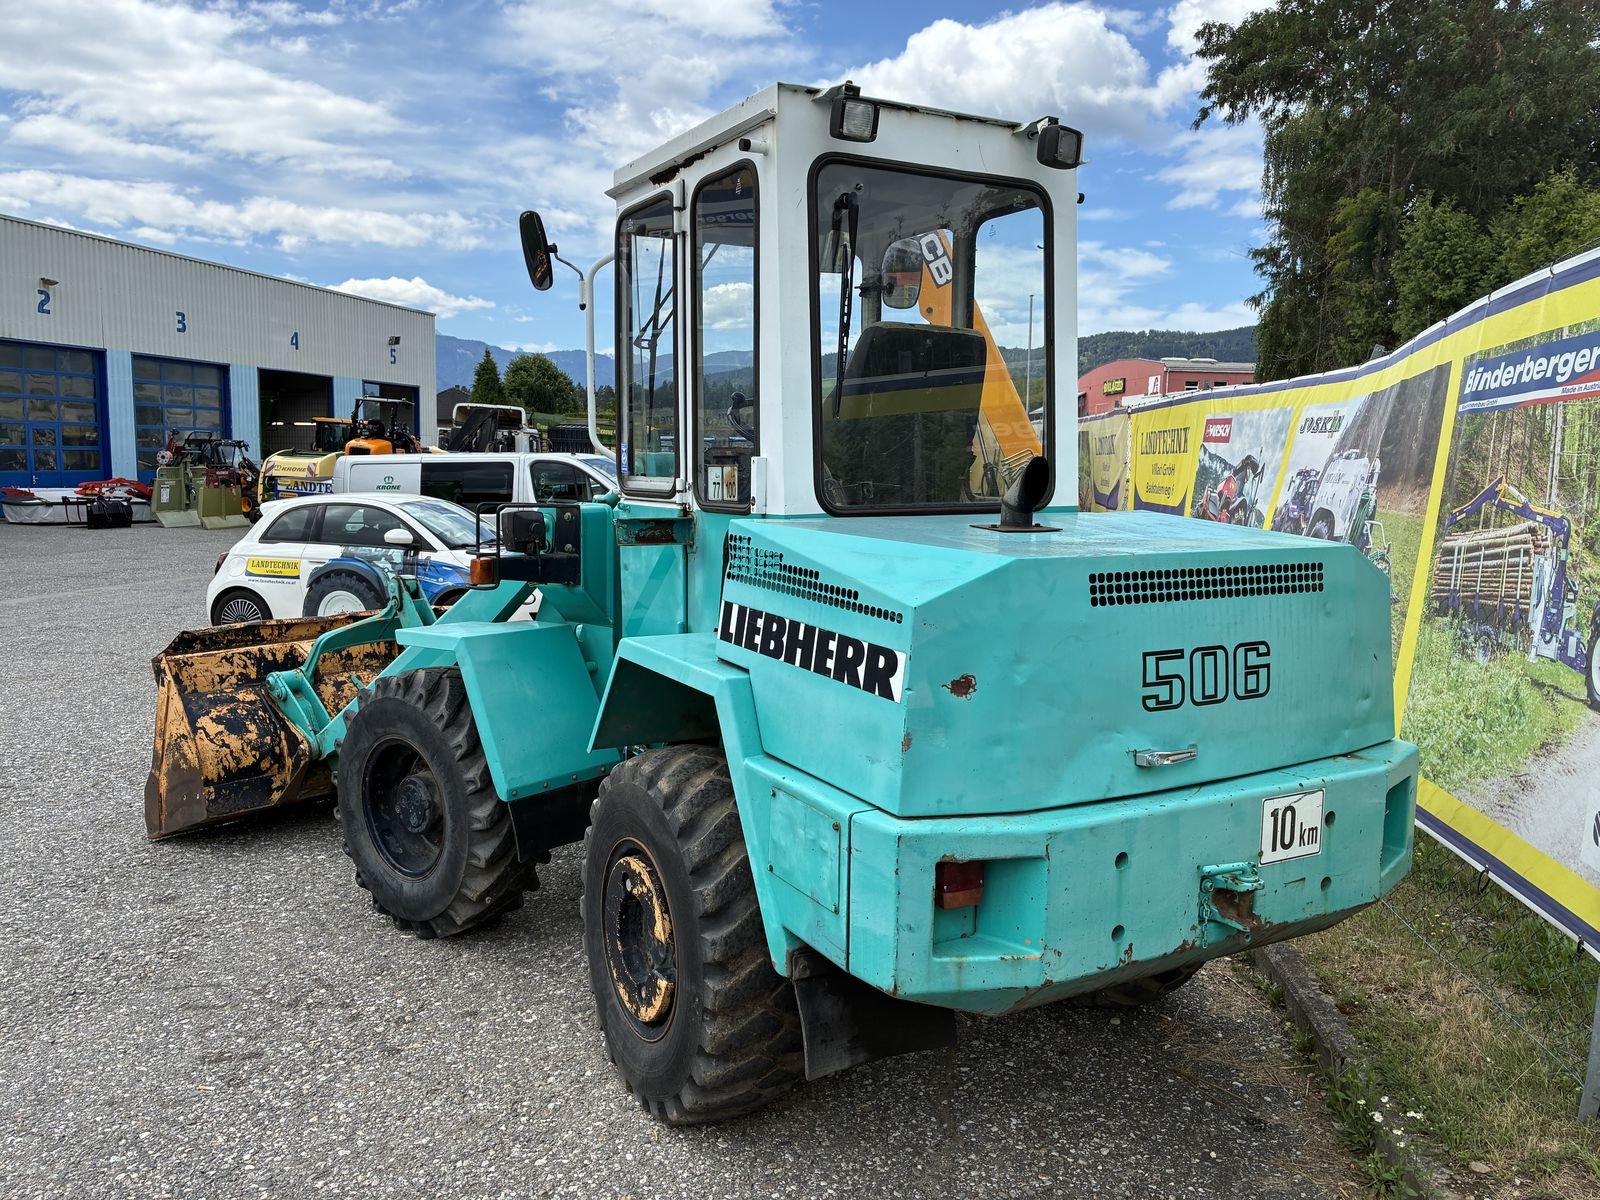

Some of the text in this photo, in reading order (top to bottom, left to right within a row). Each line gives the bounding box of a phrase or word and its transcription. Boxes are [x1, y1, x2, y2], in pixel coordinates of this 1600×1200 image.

[912, 232, 953, 285] CB
[37, 288, 51, 315] 2
[175, 311, 187, 333] 3
[290, 331, 299, 350] 4
[390, 348, 397, 365] 5
[1463, 346, 1600, 394] Binderberger
[1300, 414, 1345, 434] JOSKIN
[251, 560, 299, 570] LANDTECHNIK
[719, 599, 899, 703] LIEBHERR
[1141, 640, 1271, 713] 506
[1270, 805, 1319, 853] 10 km
